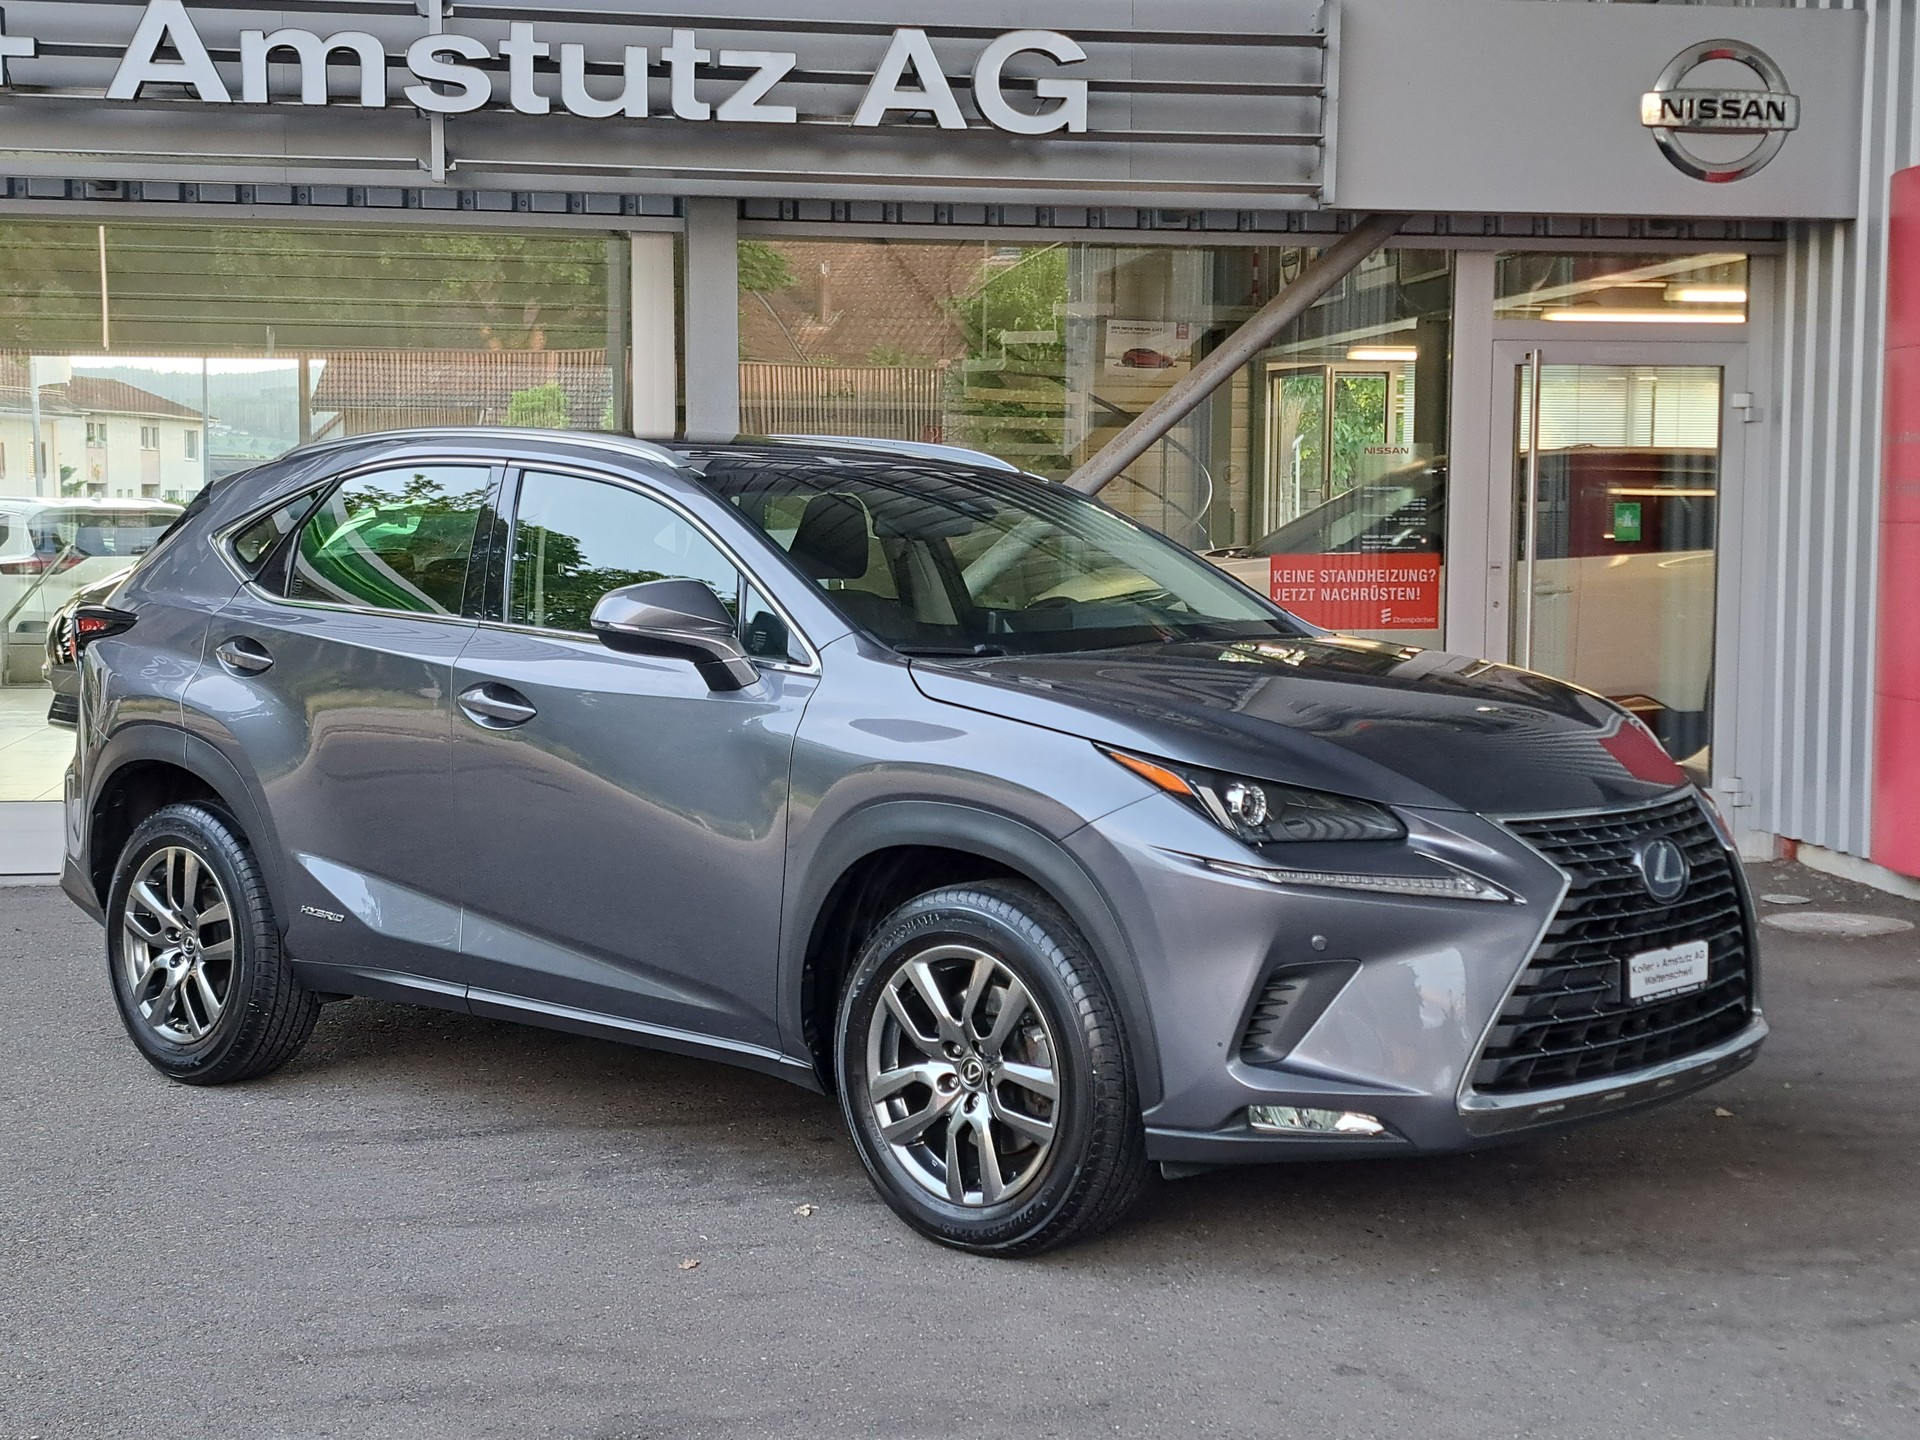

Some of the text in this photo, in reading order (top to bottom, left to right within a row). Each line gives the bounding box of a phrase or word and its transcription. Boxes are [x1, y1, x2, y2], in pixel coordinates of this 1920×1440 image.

[105, 0, 797, 122] Amstutz
[851, 28, 1088, 135] AG
[1660, 98, 1786, 122] NISSAN
[1364, 447, 1409, 455] NISSAN
[1273, 568, 1437, 583] KEINE STANDHEIZUNG?
[1273, 585, 1421, 602] JETZT NACHRÜSTEN!
[300, 904, 345, 923] HYBRID
[1662, 954, 1693, 968] Amstutz
[1695, 950, 1705, 960] AG
